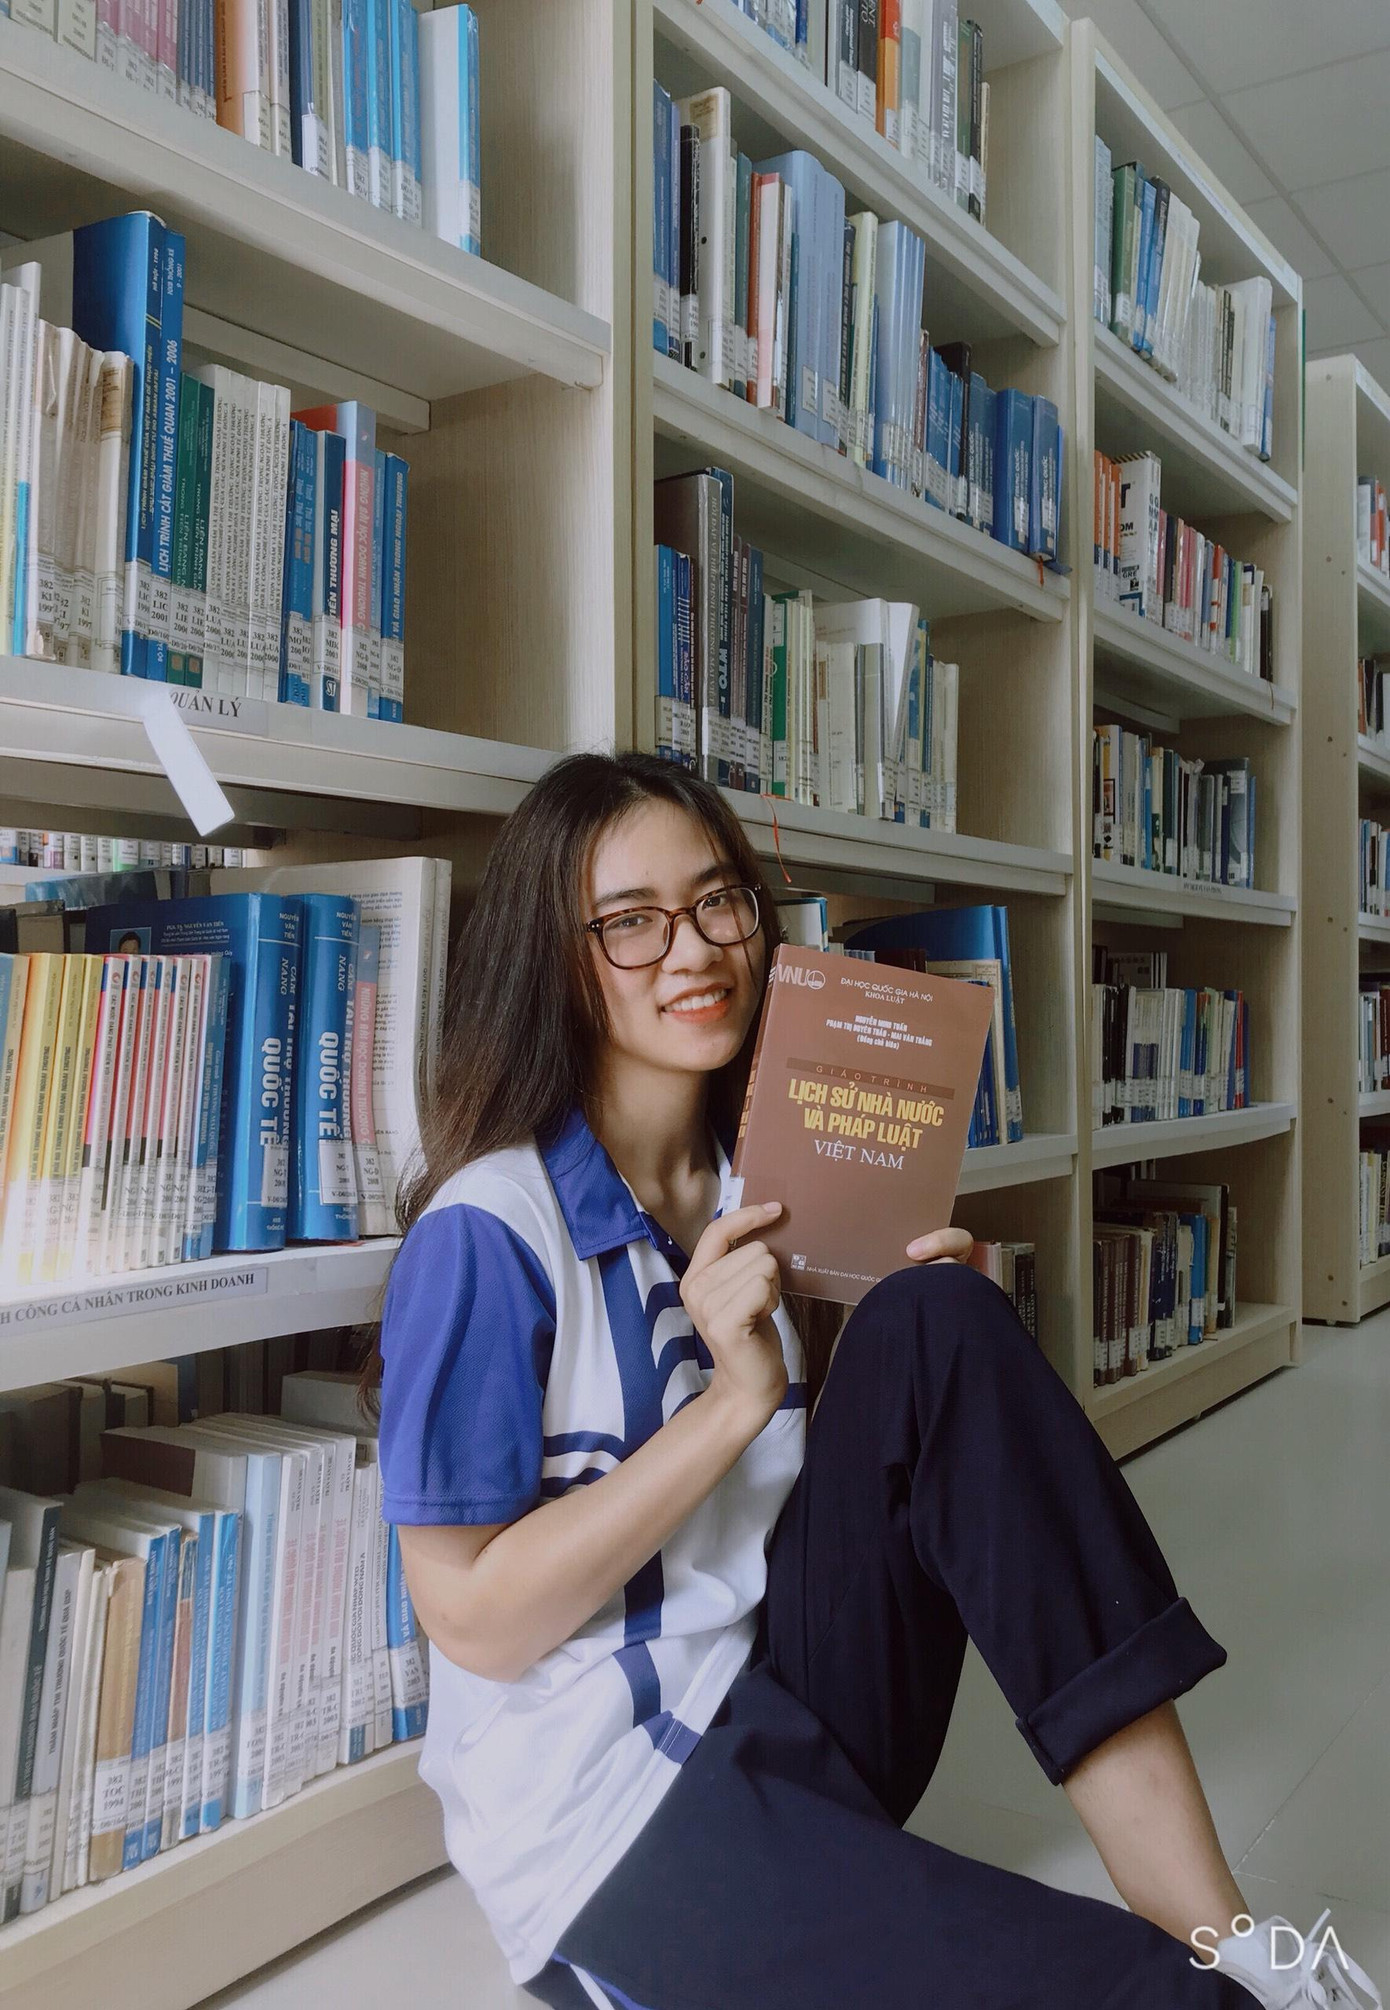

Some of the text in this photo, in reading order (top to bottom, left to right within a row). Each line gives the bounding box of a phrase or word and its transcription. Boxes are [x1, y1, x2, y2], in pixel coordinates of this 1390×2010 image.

[166, 340, 177, 366] 2006
[166, 377, 176, 402] 2001
[164, 403, 175, 435] QUAN
[160, 434, 174, 462] THUẾ
[159, 464, 173, 492] GIẢM
[396, 472, 404, 508] THƯƠNG
[158, 494, 172, 514] CẮT
[158, 515, 171, 546] TRÌNH
[330, 509, 340, 535] MẠI
[395, 510, 403, 538] NGOẠI
[357, 469, 370, 620] NHỮNG BÀI HỌC DOANH THƯƠNG
[159, 549, 171, 572] LỊCH
[328, 538, 339, 588] THƯƠNG
[152, 600, 168, 612] LIC
[154, 590, 168, 600] 382
[208, 604, 220, 614] 382
[151, 612, 168, 622] 2001
[392, 622, 400, 632] VÀ
[718, 648, 728, 690] WTO
[218, 697, 242, 717] LÝ
[280, 958, 288, 995] NANG
[338, 954, 346, 992] NANG
[778, 964, 808, 986] VNU
[840, 977, 934, 1002] ĐẠI HỌC QUỐC GIA HÀ NỘI
[865, 991, 905, 1005] KHOA LUẬT
[260, 1038, 284, 1146] QUỐC TẾ
[318, 1032, 344, 1139] QUỐC TẾ
[816, 1065, 928, 1094] GIÁO TRÌNH
[788, 1078, 945, 1127] LỊCH SỬ NHÀ NƯỚC
[804, 1105, 924, 1152] VÀ PHÁP LUẬT
[814, 1139, 905, 1170] VIỆT NAM
[15, 1304, 58, 1322] CÔNG
[61, 1297, 82, 1314] CÁ
[84, 1288, 124, 1310] NHÂN
[126, 1284, 173, 1304] TRONG
[176, 1280, 208, 1295] KINH
[211, 1274, 254, 1290] DOANH
